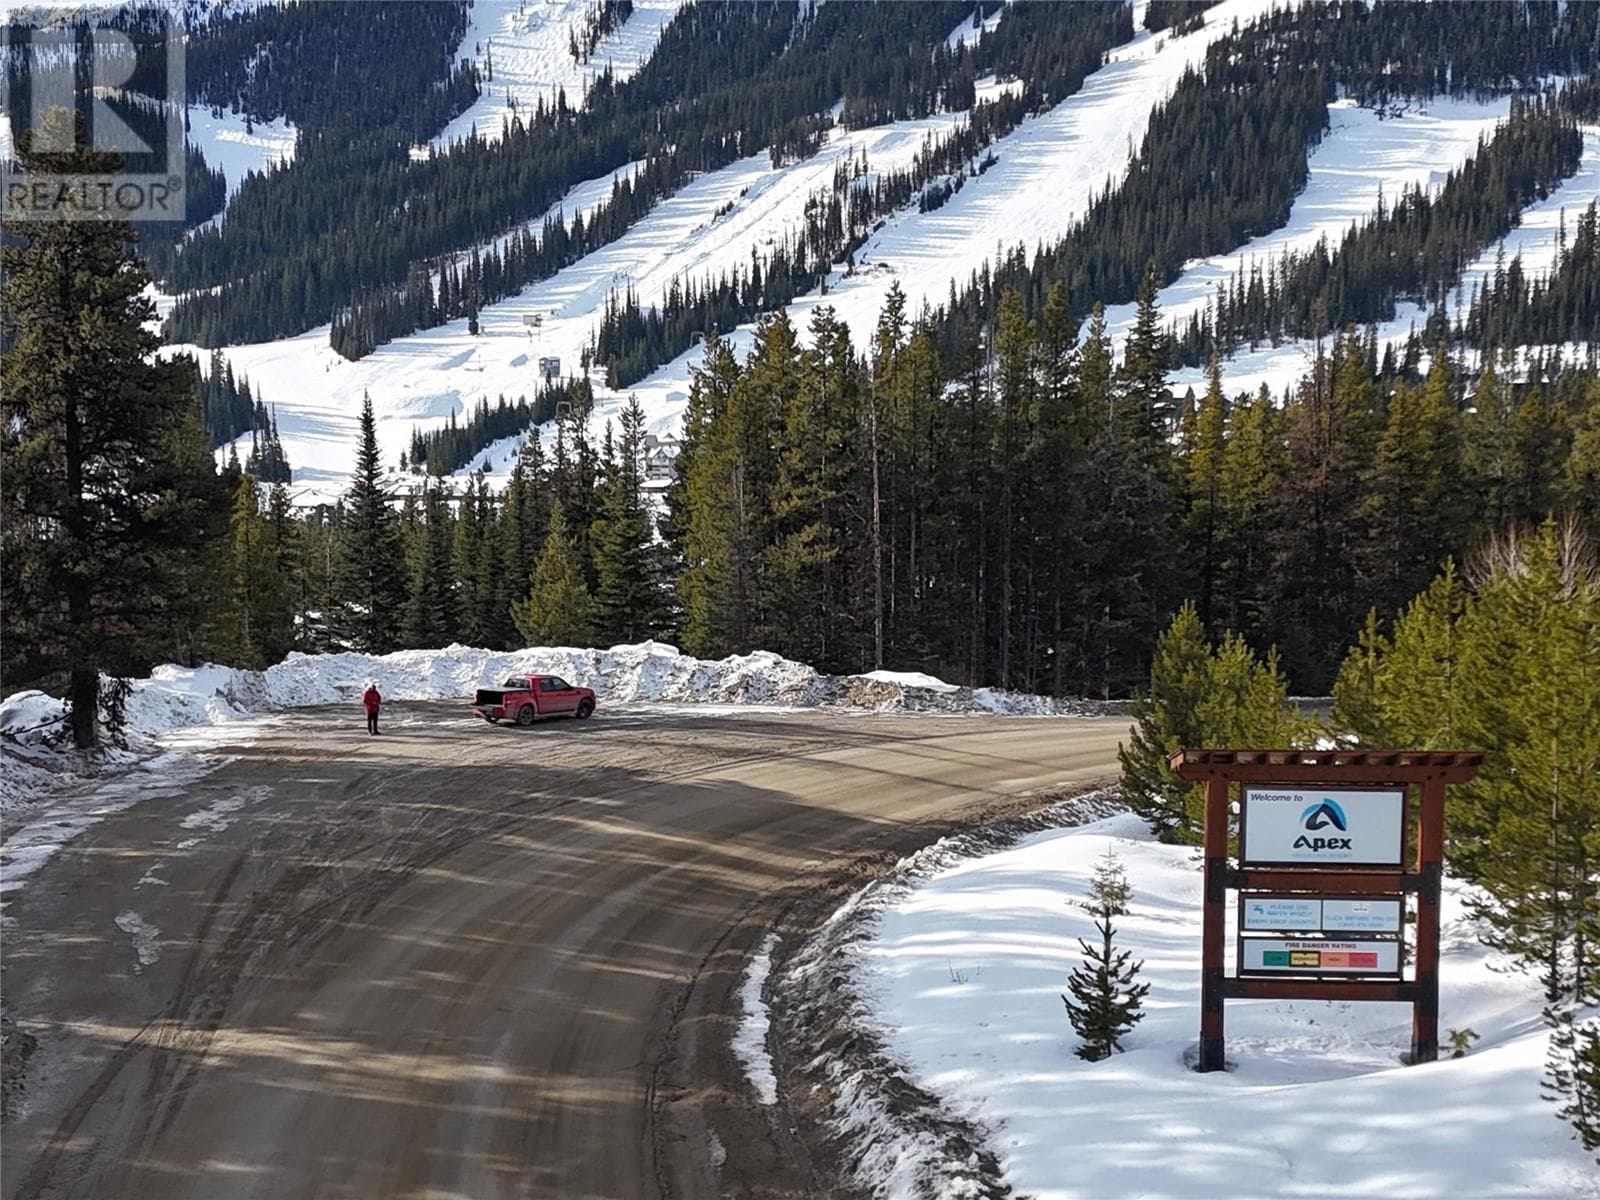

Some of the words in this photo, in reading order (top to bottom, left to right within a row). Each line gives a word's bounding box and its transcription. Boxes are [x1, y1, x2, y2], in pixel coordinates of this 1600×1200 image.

[1250, 793, 1291, 802] Welcome
[1294, 793, 1304, 802] to
[1293, 835, 1353, 852] Apex
